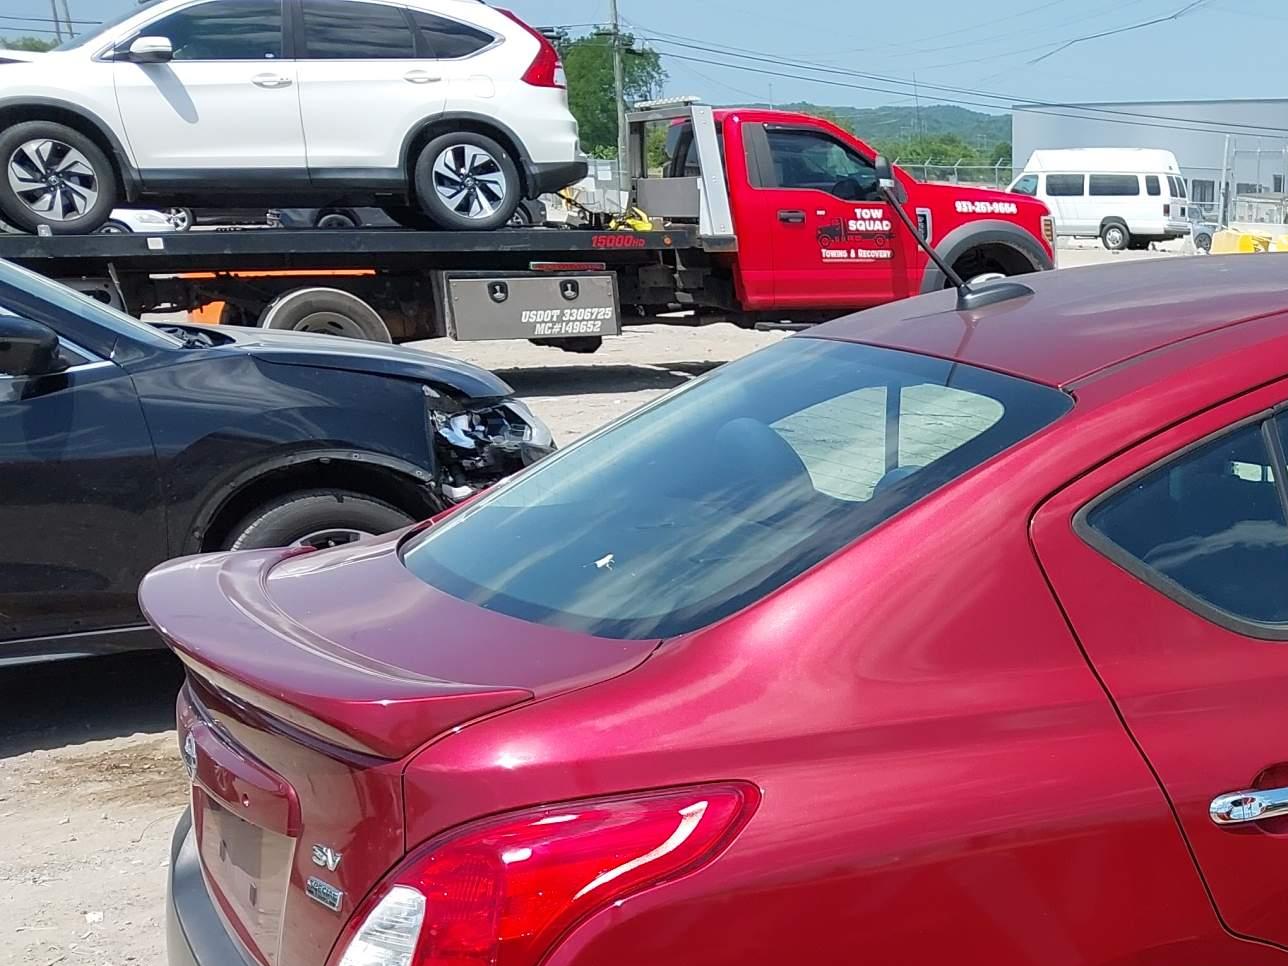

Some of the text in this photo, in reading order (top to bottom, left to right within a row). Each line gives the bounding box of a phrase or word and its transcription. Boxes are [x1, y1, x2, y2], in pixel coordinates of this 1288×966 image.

[854, 208, 883, 219] TOW
[848, 220, 891, 231] SQUAD
[850, 248, 856, 258] &
[521, 307, 612, 322] USDOT 3306725
[534, 320, 602, 335] MC#149652
[312, 844, 343, 871] SV
